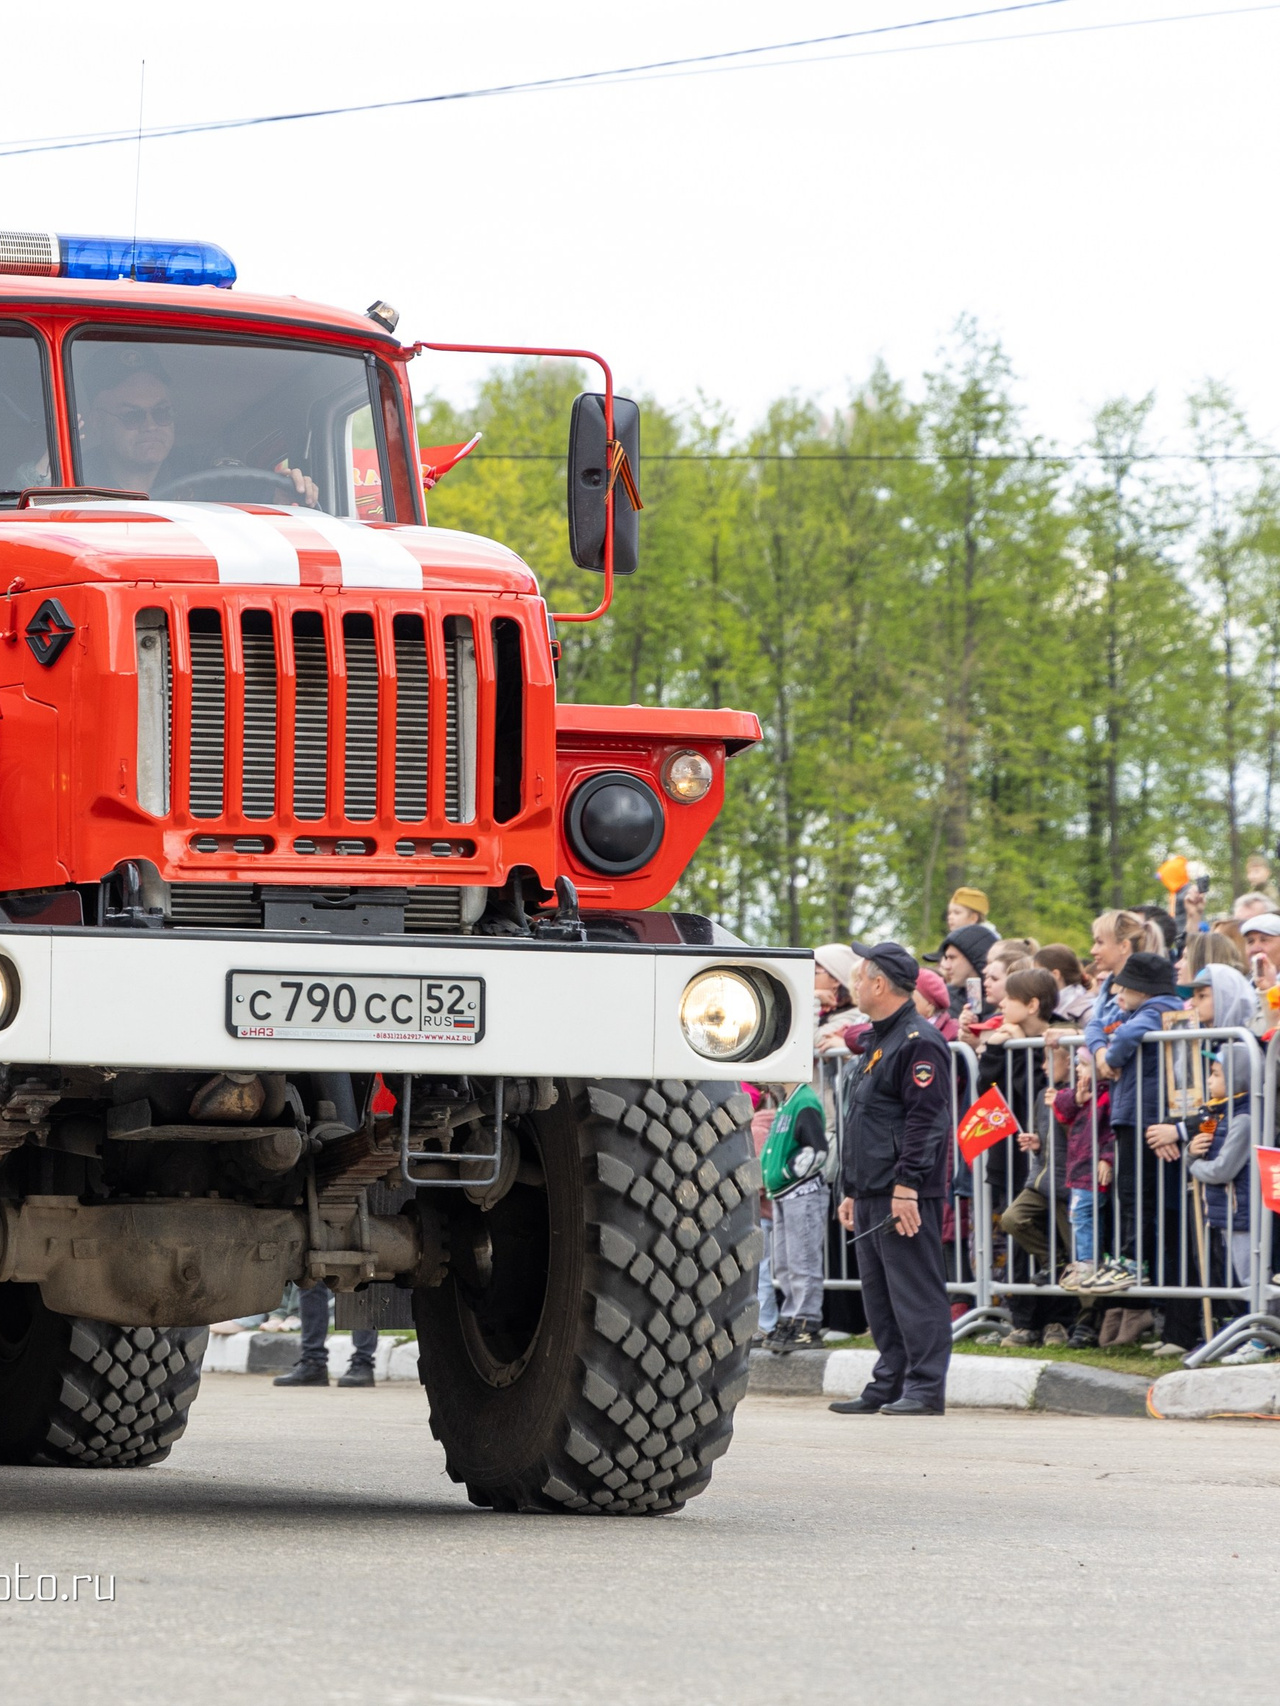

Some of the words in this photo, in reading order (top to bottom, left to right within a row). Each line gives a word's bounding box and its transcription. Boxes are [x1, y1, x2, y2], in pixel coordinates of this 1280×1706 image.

[426, 984, 465, 1015] 52
[423, 1015, 452, 1027] RUS
[249, 1027, 274, 1037] НАЗ
